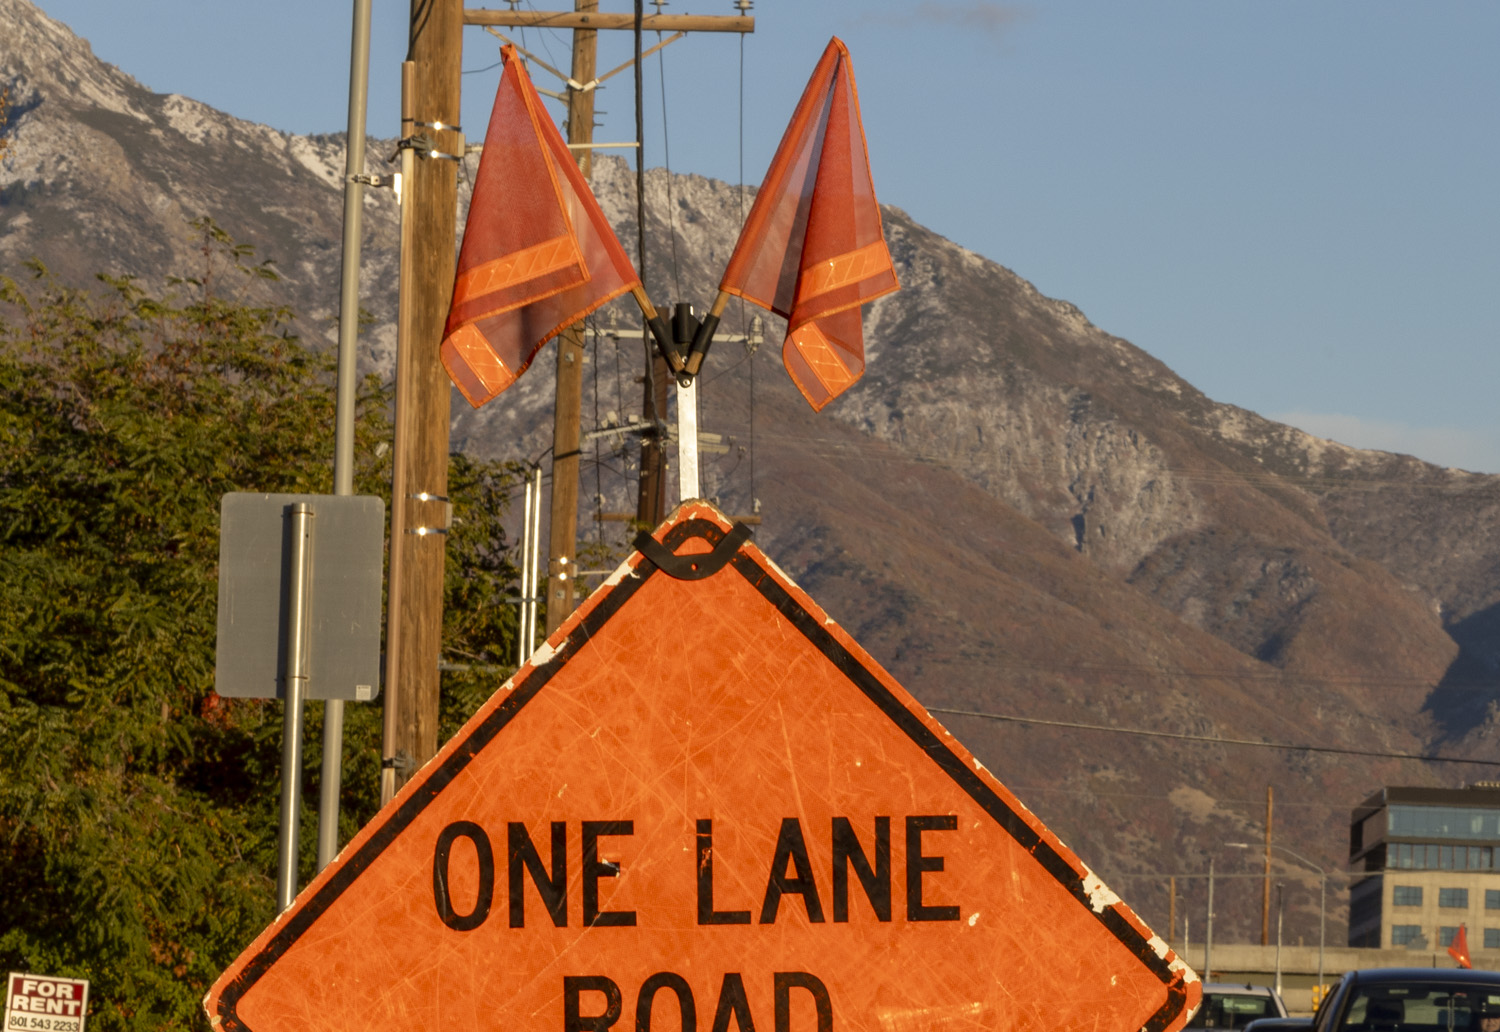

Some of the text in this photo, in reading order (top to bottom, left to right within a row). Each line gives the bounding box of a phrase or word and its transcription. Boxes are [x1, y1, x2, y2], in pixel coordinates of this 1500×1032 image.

[433, 815, 960, 931] ONE LANE
[22, 979, 74, 999] FOR
[12, 994, 81, 1015] RENT
[10, 1016, 79, 1032] 801 543 2233
